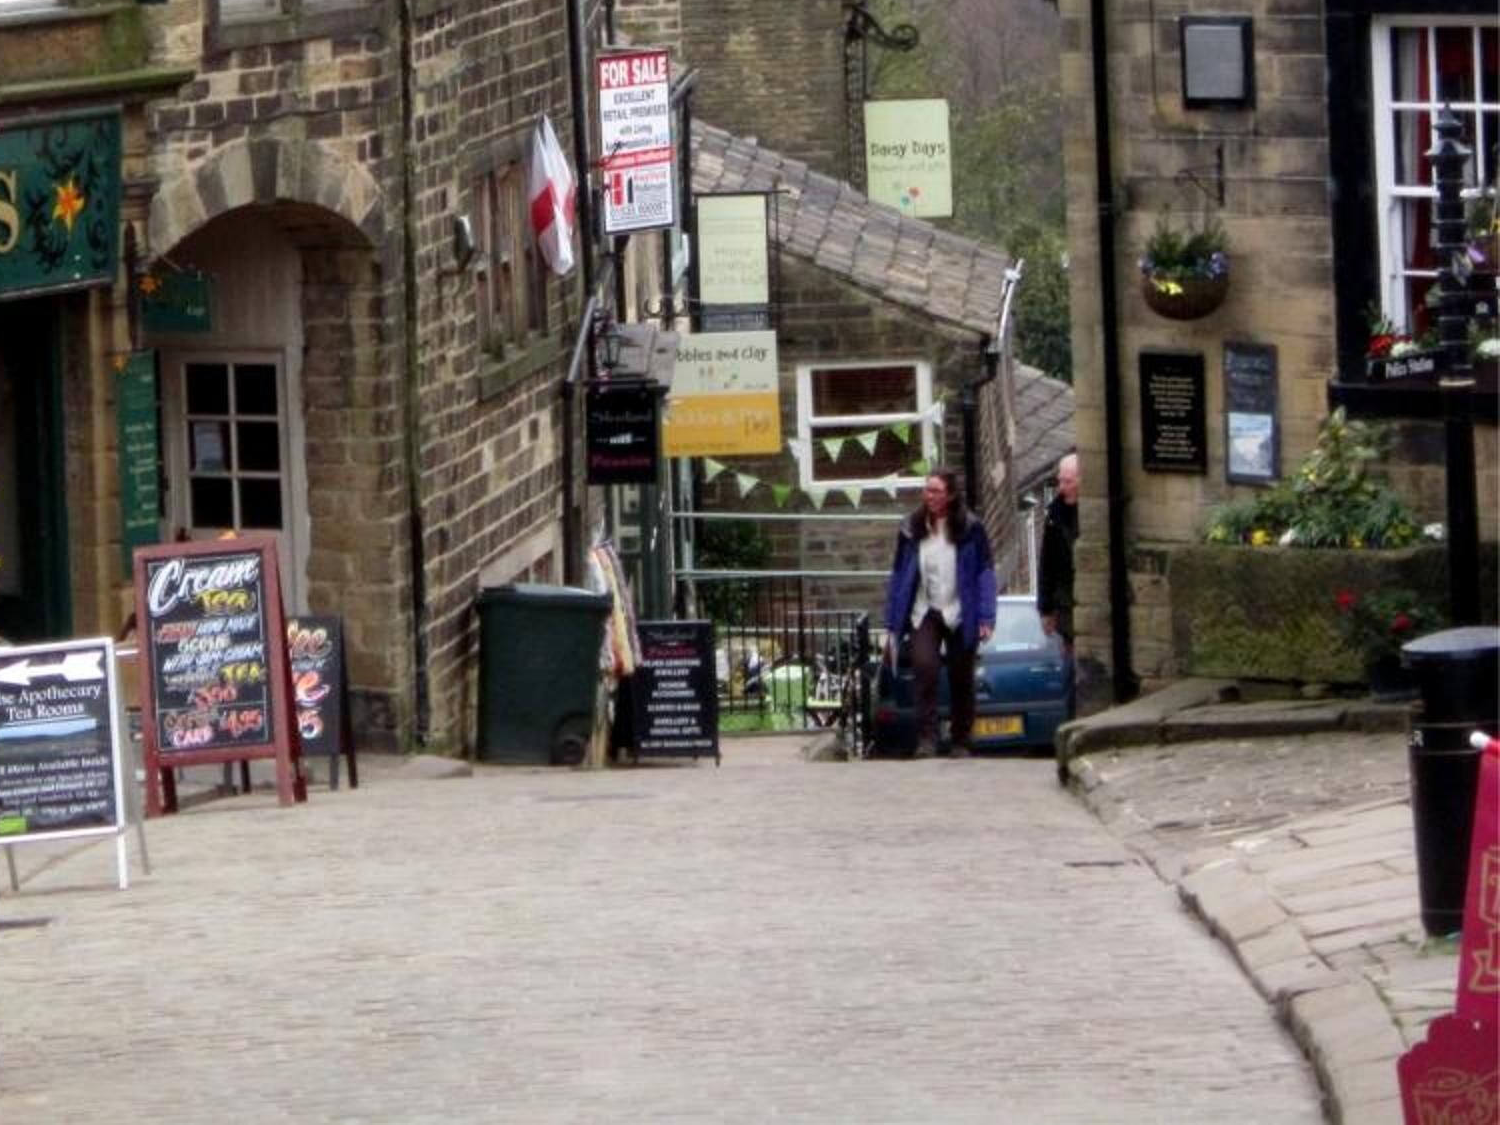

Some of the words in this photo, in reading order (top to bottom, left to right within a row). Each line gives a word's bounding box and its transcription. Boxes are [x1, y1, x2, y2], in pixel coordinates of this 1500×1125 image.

[601, 60, 629, 88] FOR
[632, 55, 667, 84] SALE
[871, 142, 906, 159] Daisy
[912, 140, 946, 158] Days
[676, 347, 713, 364] bbles
[148, 558, 260, 617] Cream
[19, 683, 101, 706] Apothecary
[6, 706, 32, 721] Tea
[37, 702, 84, 718] Rooms
